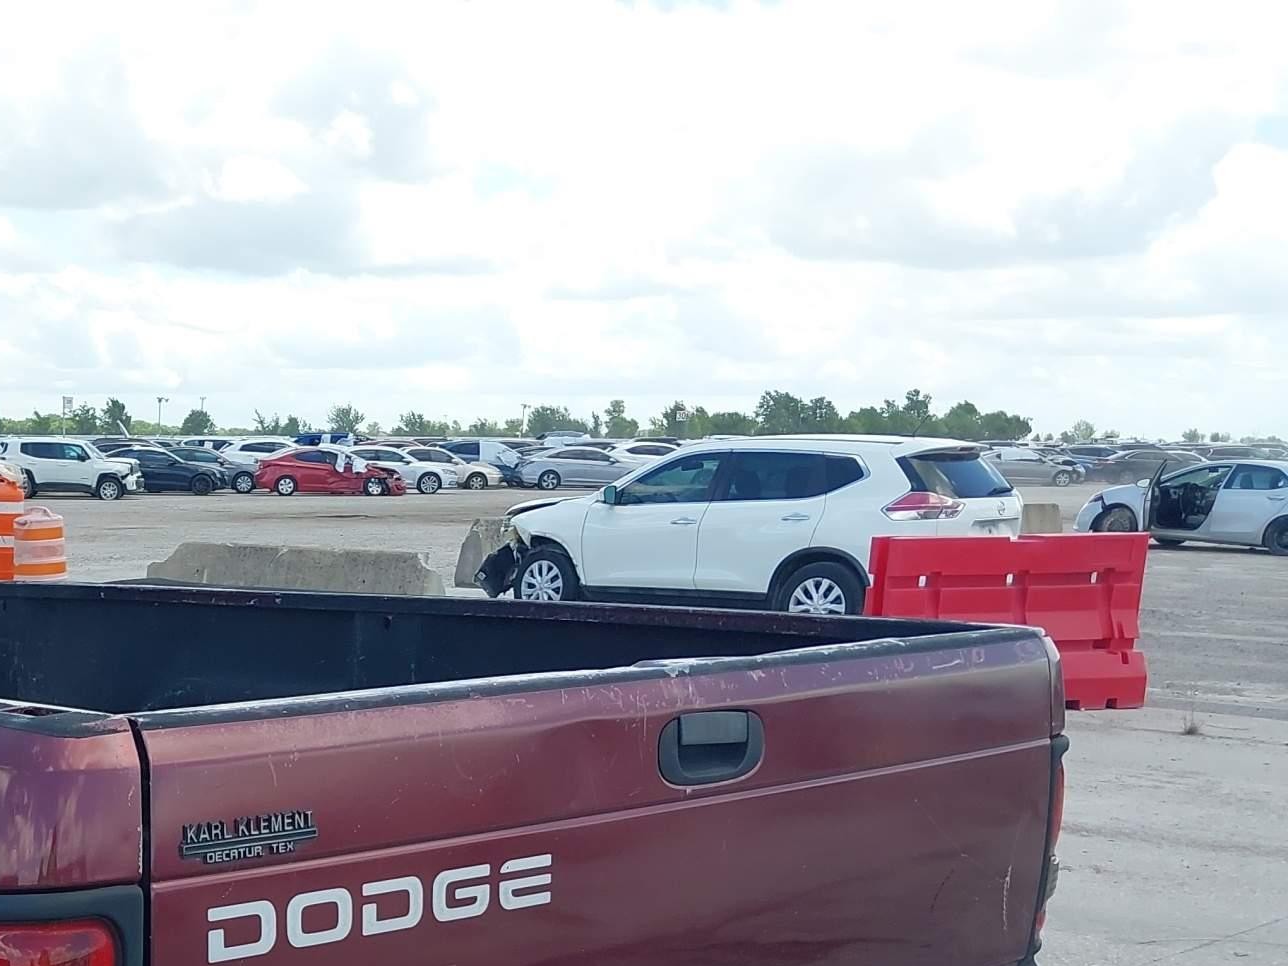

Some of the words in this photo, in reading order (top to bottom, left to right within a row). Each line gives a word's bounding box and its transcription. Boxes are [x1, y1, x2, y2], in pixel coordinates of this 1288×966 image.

[186, 822, 233, 843] KARL
[238, 810, 313, 836] KLEMENT
[271, 841, 294, 853] TEX
[207, 853, 552, 964] DODGE
